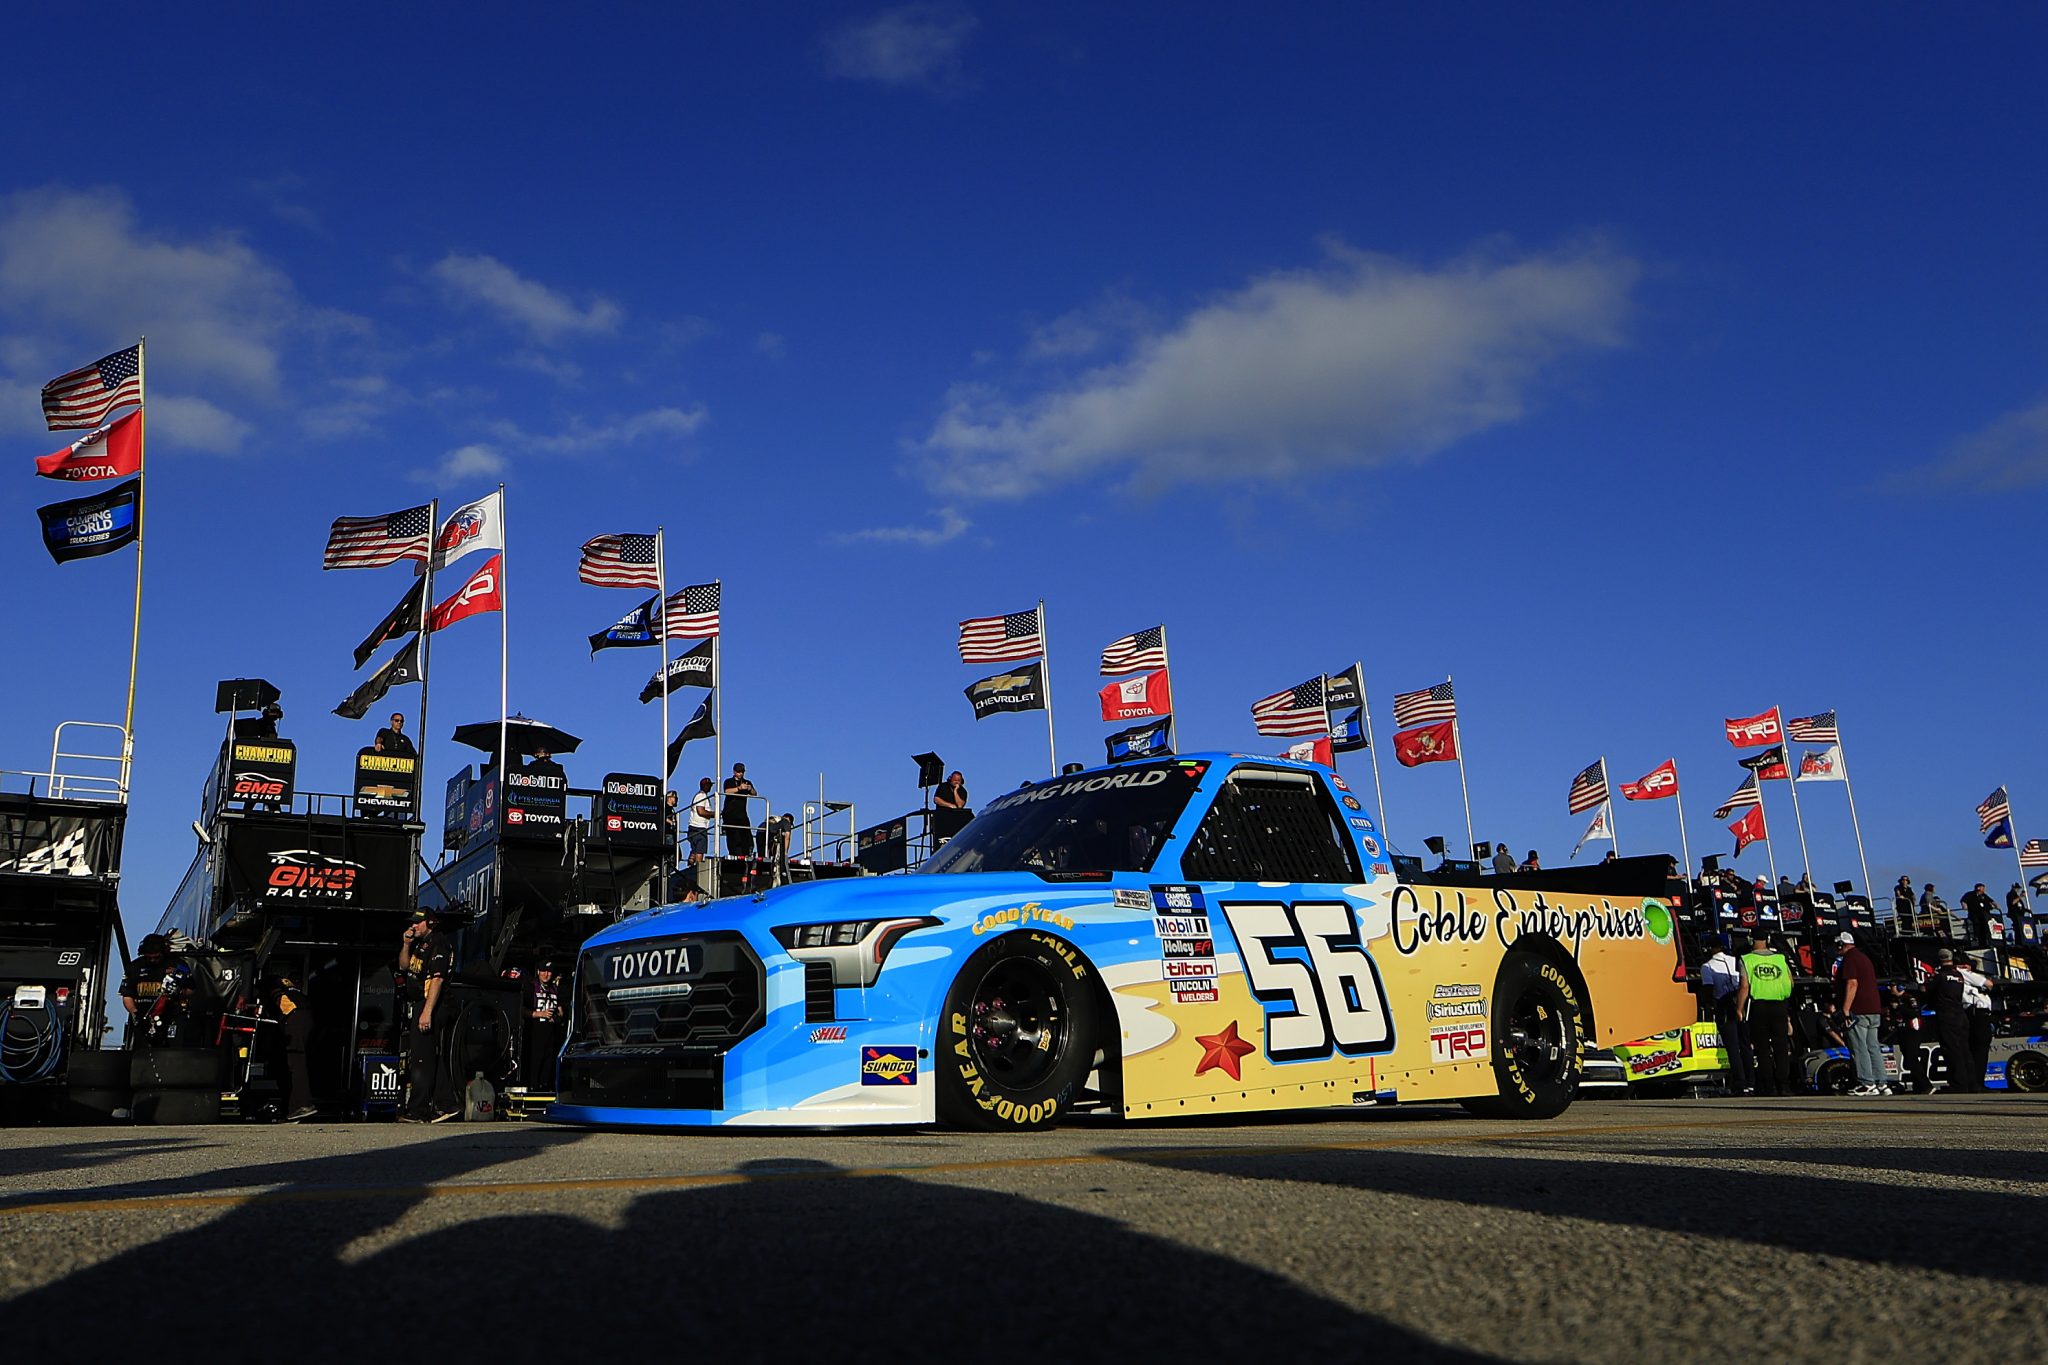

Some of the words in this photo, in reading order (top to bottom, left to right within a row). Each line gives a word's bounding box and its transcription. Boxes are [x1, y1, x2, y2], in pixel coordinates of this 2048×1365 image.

[65, 465, 117, 479] TOYOTA
[66, 510, 111, 527] CAMPING
[68, 519, 113, 536] WORLD
[88, 532, 110, 543] SERIES
[975, 692, 1036, 710] CHEVROLET
[1118, 706, 1154, 717] TOYOTA
[235, 744, 292, 762] CHAMPION
[359, 754, 414, 771] CHAMPION
[508, 773, 547, 788] Mobil
[547, 777, 560, 788] 1
[1060, 769, 1168, 797] WORLD
[235, 781, 284, 795] GMS
[607, 782, 643, 796] Mobil
[643, 784, 656, 796] 1
[233, 792, 282, 801] RACING
[357, 797, 412, 808] CHEVROLET
[525, 813, 561, 824] TOYOTA
[623, 820, 658, 831] TOYOTA
[268, 865, 356, 889] GMS
[1165, 893, 1191, 901] CAMPING
[1167, 899, 1193, 908] WORLD
[1156, 918, 1194, 933] Mobil
[1195, 918, 1208, 933] 1
[1391, 885, 1487, 955] Coble
[1492, 887, 1646, 959] Enterprises
[1164, 940, 1194, 957] Holley
[57, 952, 81, 965] 99
[612, 947, 690, 980] TOYOTA
[1166, 962, 1214, 976] tilton
[1758, 966, 1775, 975] FOX
[1171, 980, 1210, 992] LINCOLN
[1219, 901, 1394, 1058] 56
[1180, 992, 1214, 1002] WELDERS
[1434, 1002, 1481, 1017] SiriusXM
[819, 1026, 848, 1041] HILL
[1459, 1022, 1485, 1031] DEVELOPMENT
[1430, 1029, 1486, 1059] TRD
[865, 1062, 913, 1072] SUNOCO
[1503, 1047, 1536, 1104] EAGLE
